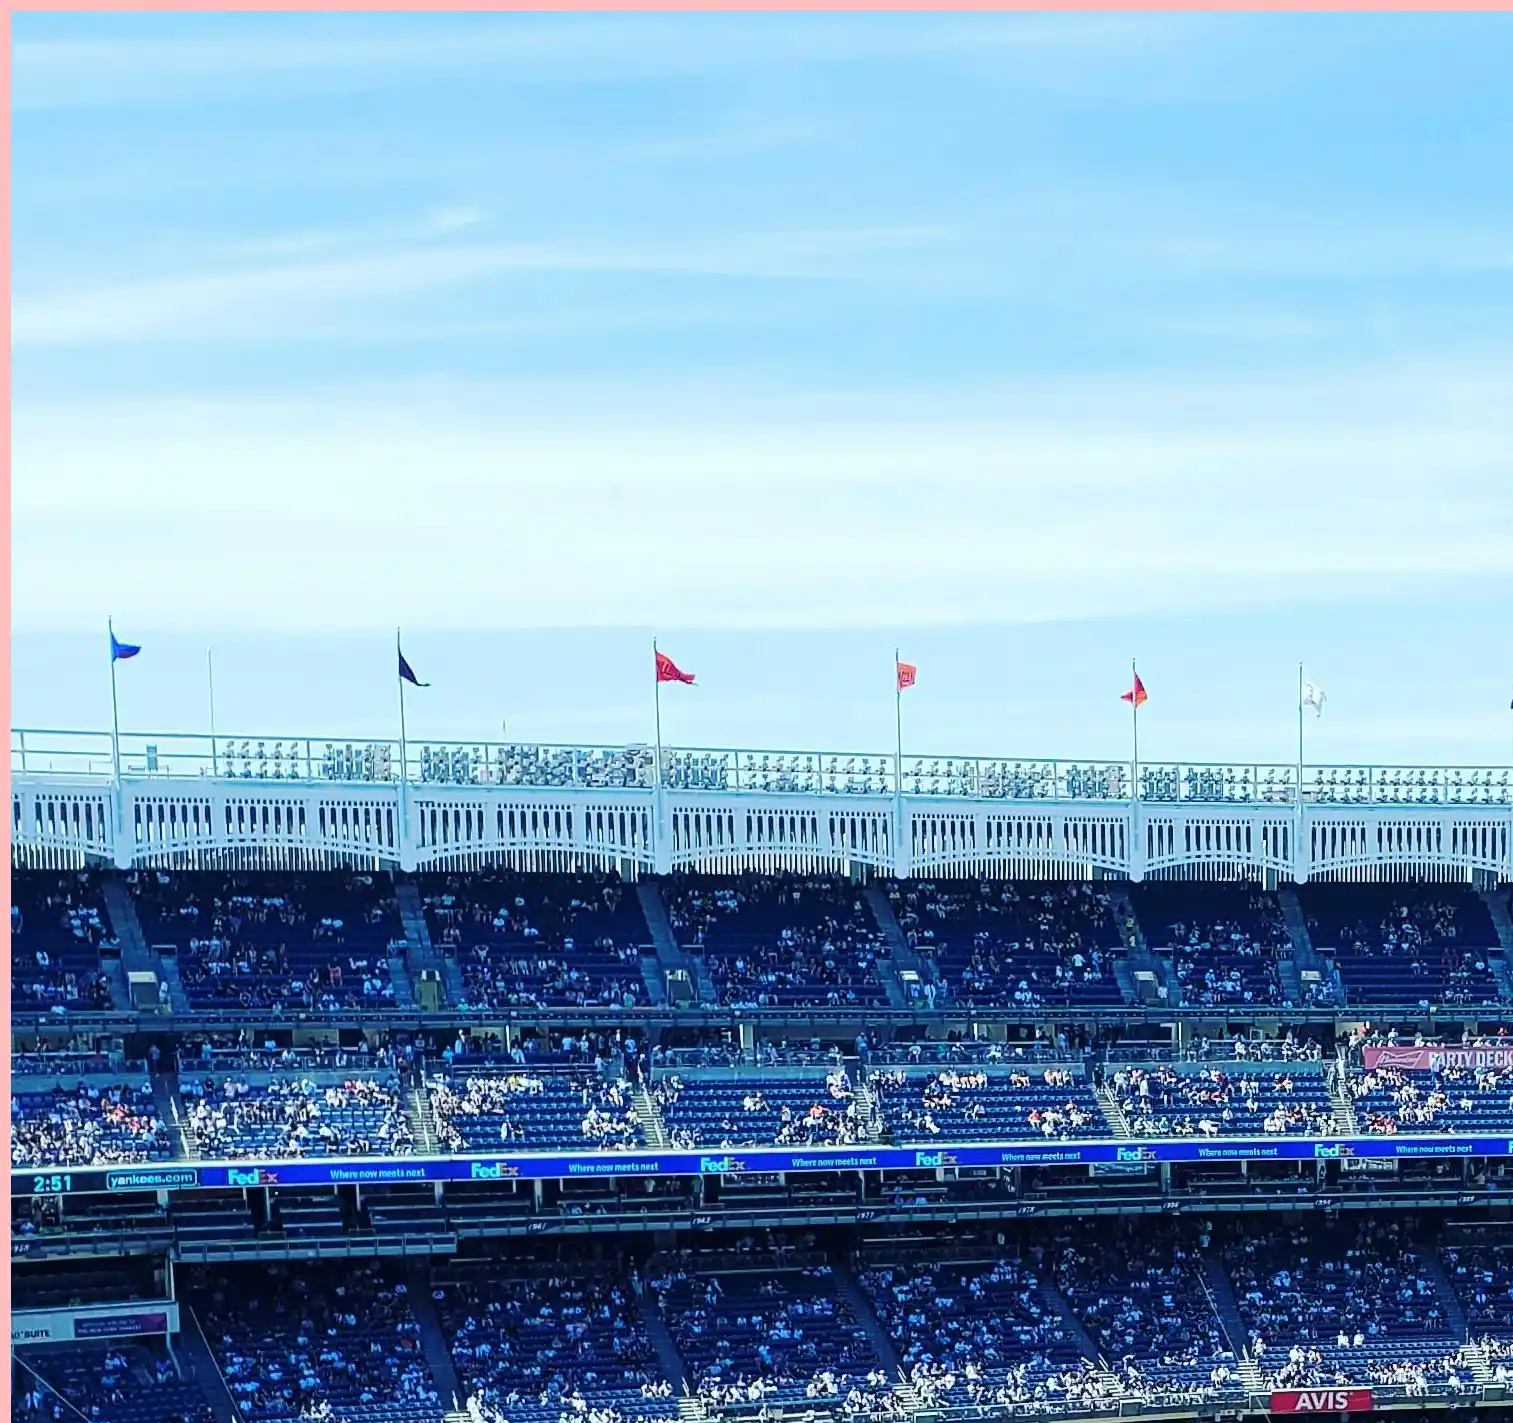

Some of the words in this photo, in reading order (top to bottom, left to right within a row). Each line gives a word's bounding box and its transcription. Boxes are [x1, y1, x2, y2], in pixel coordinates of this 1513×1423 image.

[1428, 1050, 1473, 1067] PARTY
[1475, 1050, 1513, 1067] DECK
[1117, 1147, 1156, 1161] FedEx
[1314, 1144, 1354, 1157] FedEx
[701, 1157, 745, 1172] FedEx
[792, 1159, 816, 1167] Where
[916, 1152, 958, 1166] FedEx
[330, 1169, 358, 1179] Where
[360, 1170, 377, 1178] now
[471, 1163, 518, 1178] FedEx
[569, 1163, 594, 1172] Where
[34, 1175, 72, 1192] 2:51
[110, 1172, 193, 1187] yankees.com
[228, 1169, 278, 1186] FedEx
[1295, 1392, 1349, 1411] AVIS
